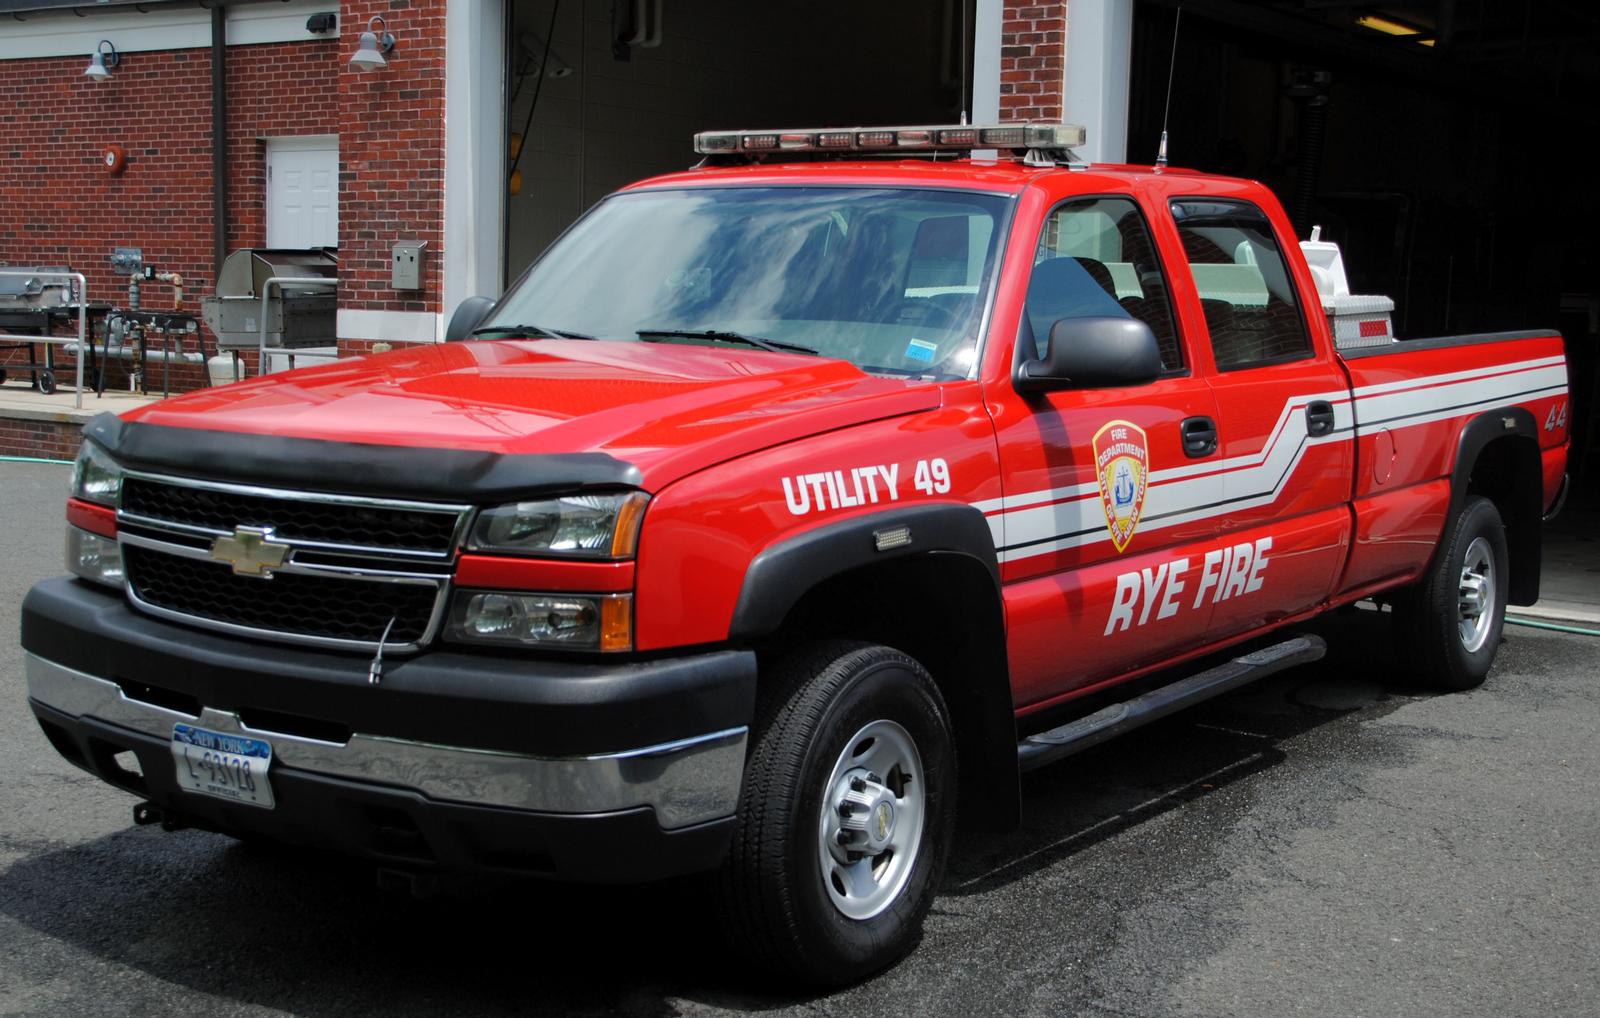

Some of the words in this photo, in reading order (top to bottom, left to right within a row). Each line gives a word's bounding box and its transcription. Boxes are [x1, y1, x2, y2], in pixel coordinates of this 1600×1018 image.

[1098, 443, 1145, 467] DEPARTMENT
[1110, 428, 1127, 441] FIRE
[781, 463, 899, 516] UTILITY
[913, 457, 951, 496] 49
[1100, 471, 1110, 500] CITY
[1105, 503, 1115, 520] OF
[1111, 521, 1123, 544] RYE
[1123, 506, 1139, 540] NEW
[1136, 465, 1147, 503] YORK
[1103, 557, 1189, 637] RYE
[1192, 536, 1273, 610] FIRE
[194, 732, 216, 749] NEW
[217, 737, 244, 755] YORK
